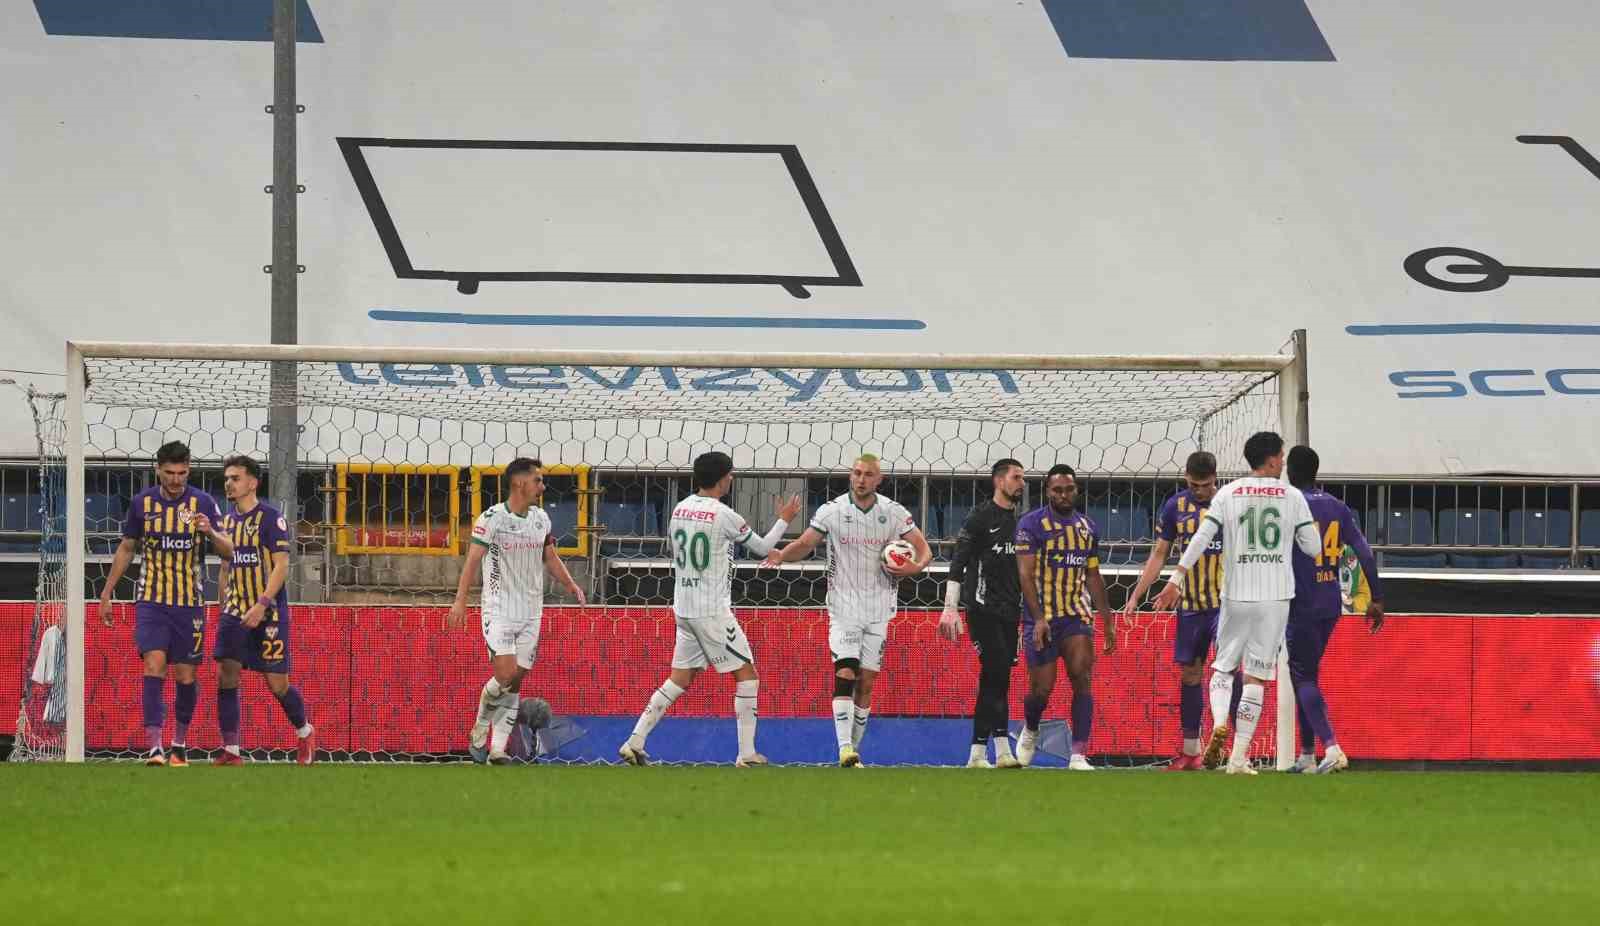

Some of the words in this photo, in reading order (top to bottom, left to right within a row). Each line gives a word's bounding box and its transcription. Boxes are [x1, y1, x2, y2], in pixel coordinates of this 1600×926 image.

[1239, 505, 1281, 551] 16
[161, 536, 192, 549] ikas
[674, 528, 710, 572] 30
[233, 550, 257, 563] ikas
[192, 631, 203, 653] 7
[261, 639, 285, 660] 22
